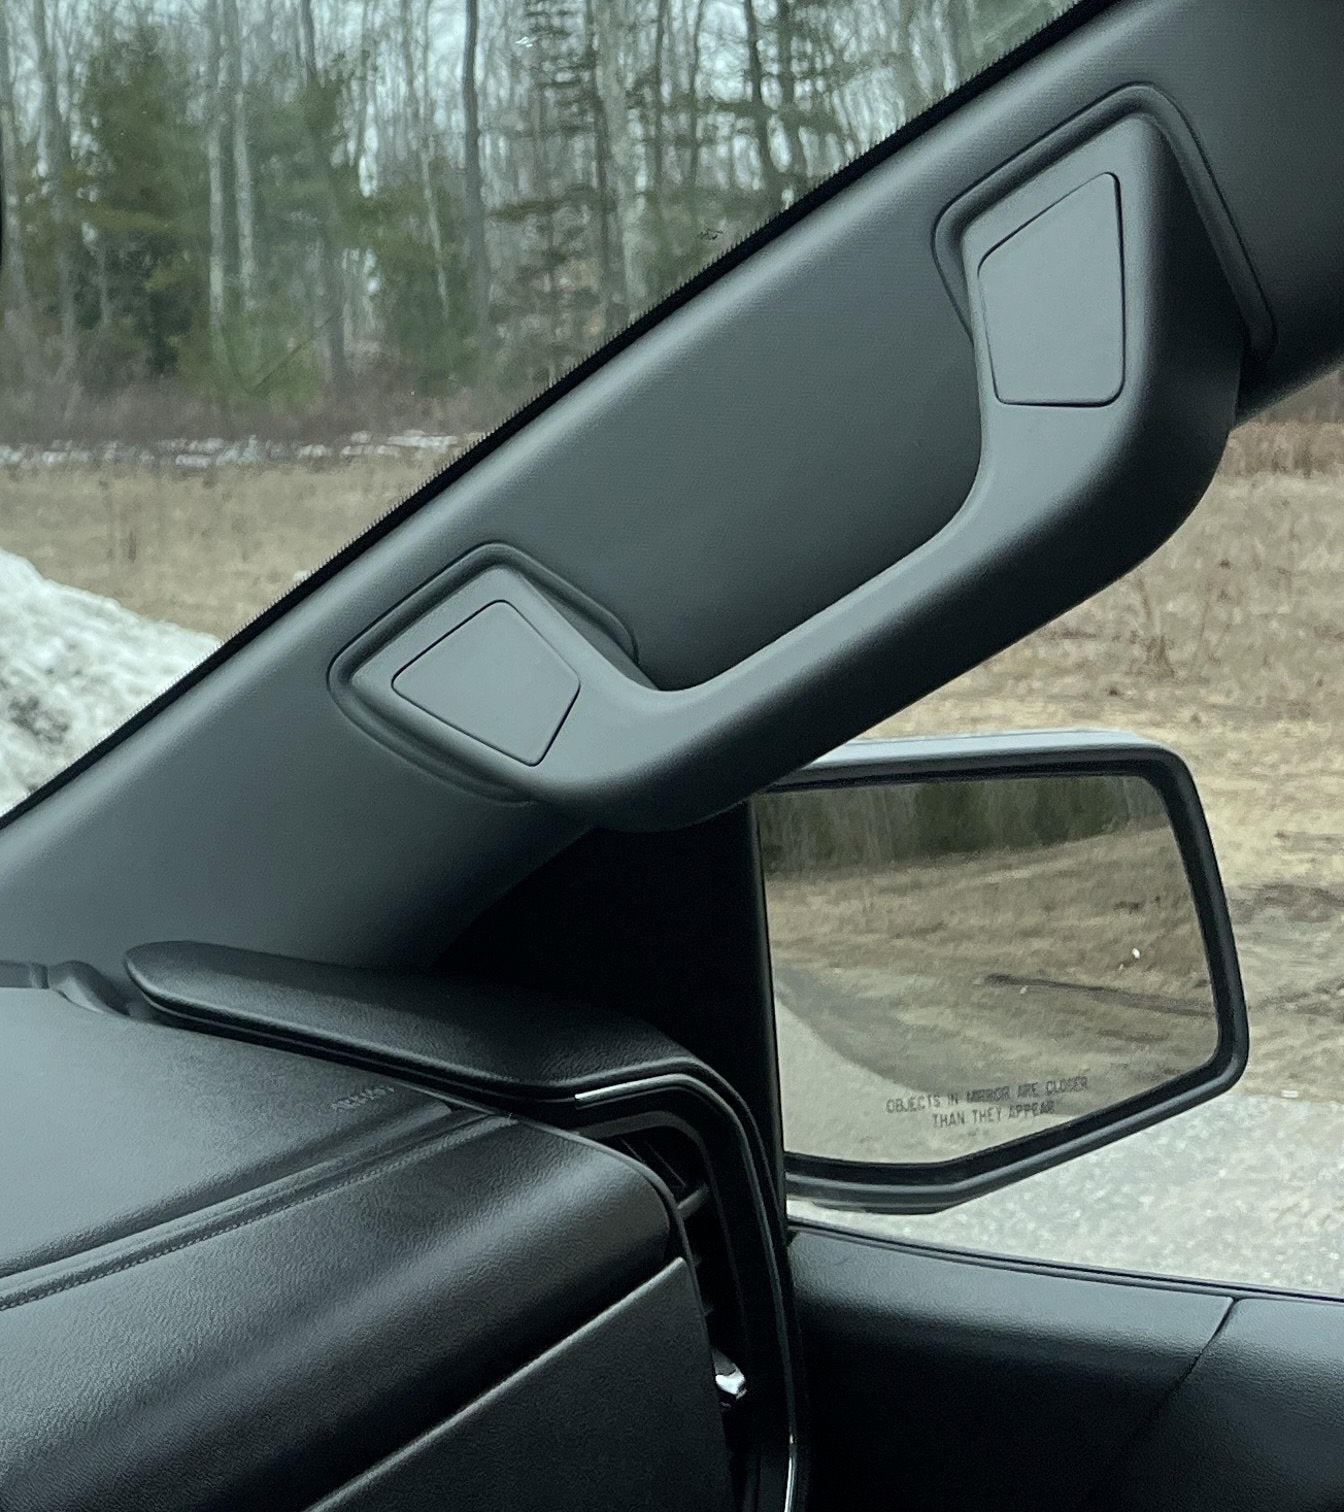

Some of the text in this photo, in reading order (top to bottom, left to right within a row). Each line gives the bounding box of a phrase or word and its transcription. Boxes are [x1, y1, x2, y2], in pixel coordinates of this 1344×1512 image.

[886, 1076, 1089, 1113] OBJECTS IN MIRROR ARE CLOSER
[932, 1100, 1056, 1128] THAN THEY APPEAR
